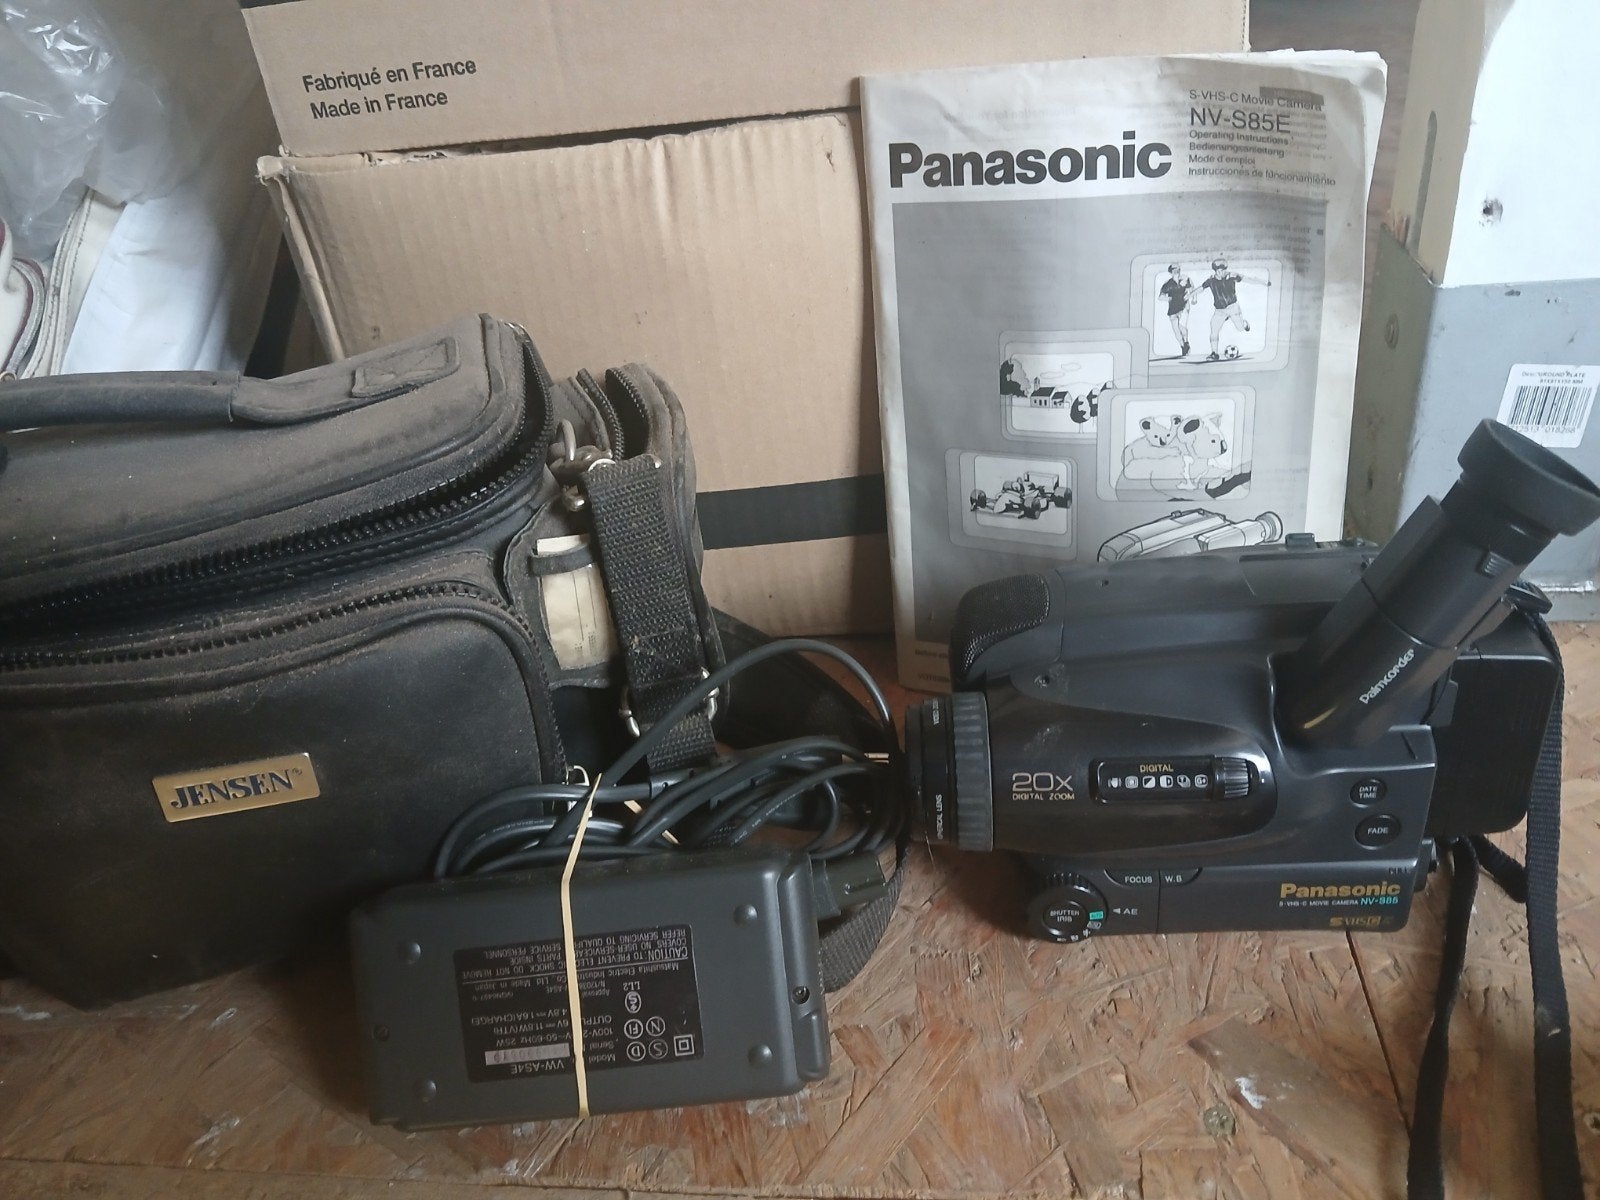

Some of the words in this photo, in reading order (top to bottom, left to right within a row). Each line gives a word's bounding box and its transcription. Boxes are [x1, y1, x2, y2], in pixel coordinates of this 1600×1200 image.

[302, 66, 381, 93] Fabriqué
[386, 67, 409, 83] en
[412, 59, 477, 80] France
[310, 99, 361, 119] Made
[364, 96, 381, 113] in
[385, 91, 448, 111] France
[1189, 89, 1239, 103] S-VHS-C
[1241, 92, 1274, 106] Movie
[1277, 98, 1322, 112] Camera
[1190, 107, 1291, 134] NV-S85E
[1189, 129, 1235, 141] Operating
[1236, 133, 1289, 146] Instructions
[1189, 142, 1285, 158] Bedienungsanleitung
[888, 130, 1172, 189] Panasonic
[1188, 154, 1215, 163] Mode
[1188, 167, 1250, 177] Instrucciones
[1251, 169, 1263, 178] de
[1265, 169, 1336, 186] funcionamiento
[1359, 649, 1414, 704] Palmcorder
[1139, 763, 1174, 773] DIGITAL
[170, 768, 293, 809] JENSEN
[1012, 793, 1044, 801] DIGITAL
[1049, 793, 1075, 801] ZOOM
[1367, 827, 1389, 835] FADE
[1124, 876, 1153, 884] FOCUS
[1280, 881, 1401, 899] Panasonic
[1123, 908, 1138, 916] AE
[619, 931, 659, 944] SERVICING
[662, 929, 686, 939] REFER
[606, 936, 615, 945] TO
[641, 941, 652, 950] NO
[530, 943, 561, 954] SERVICE
[536, 952, 561, 962] PARTS
[597, 953, 631, 965] PREVENT
[633, 951, 643, 960] TO
[496, 967, 510, 976] NOT
[512, 965, 524, 973] DO
[608, 967, 636, 976] Electric
[638, 962, 679, 973] Matsushita
[475, 982, 496, 991] Japan
[511, 980, 531, 988] Made
[588, 1053, 616, 1064] Model
[510, 1059, 564, 1074] VW-AS4E
